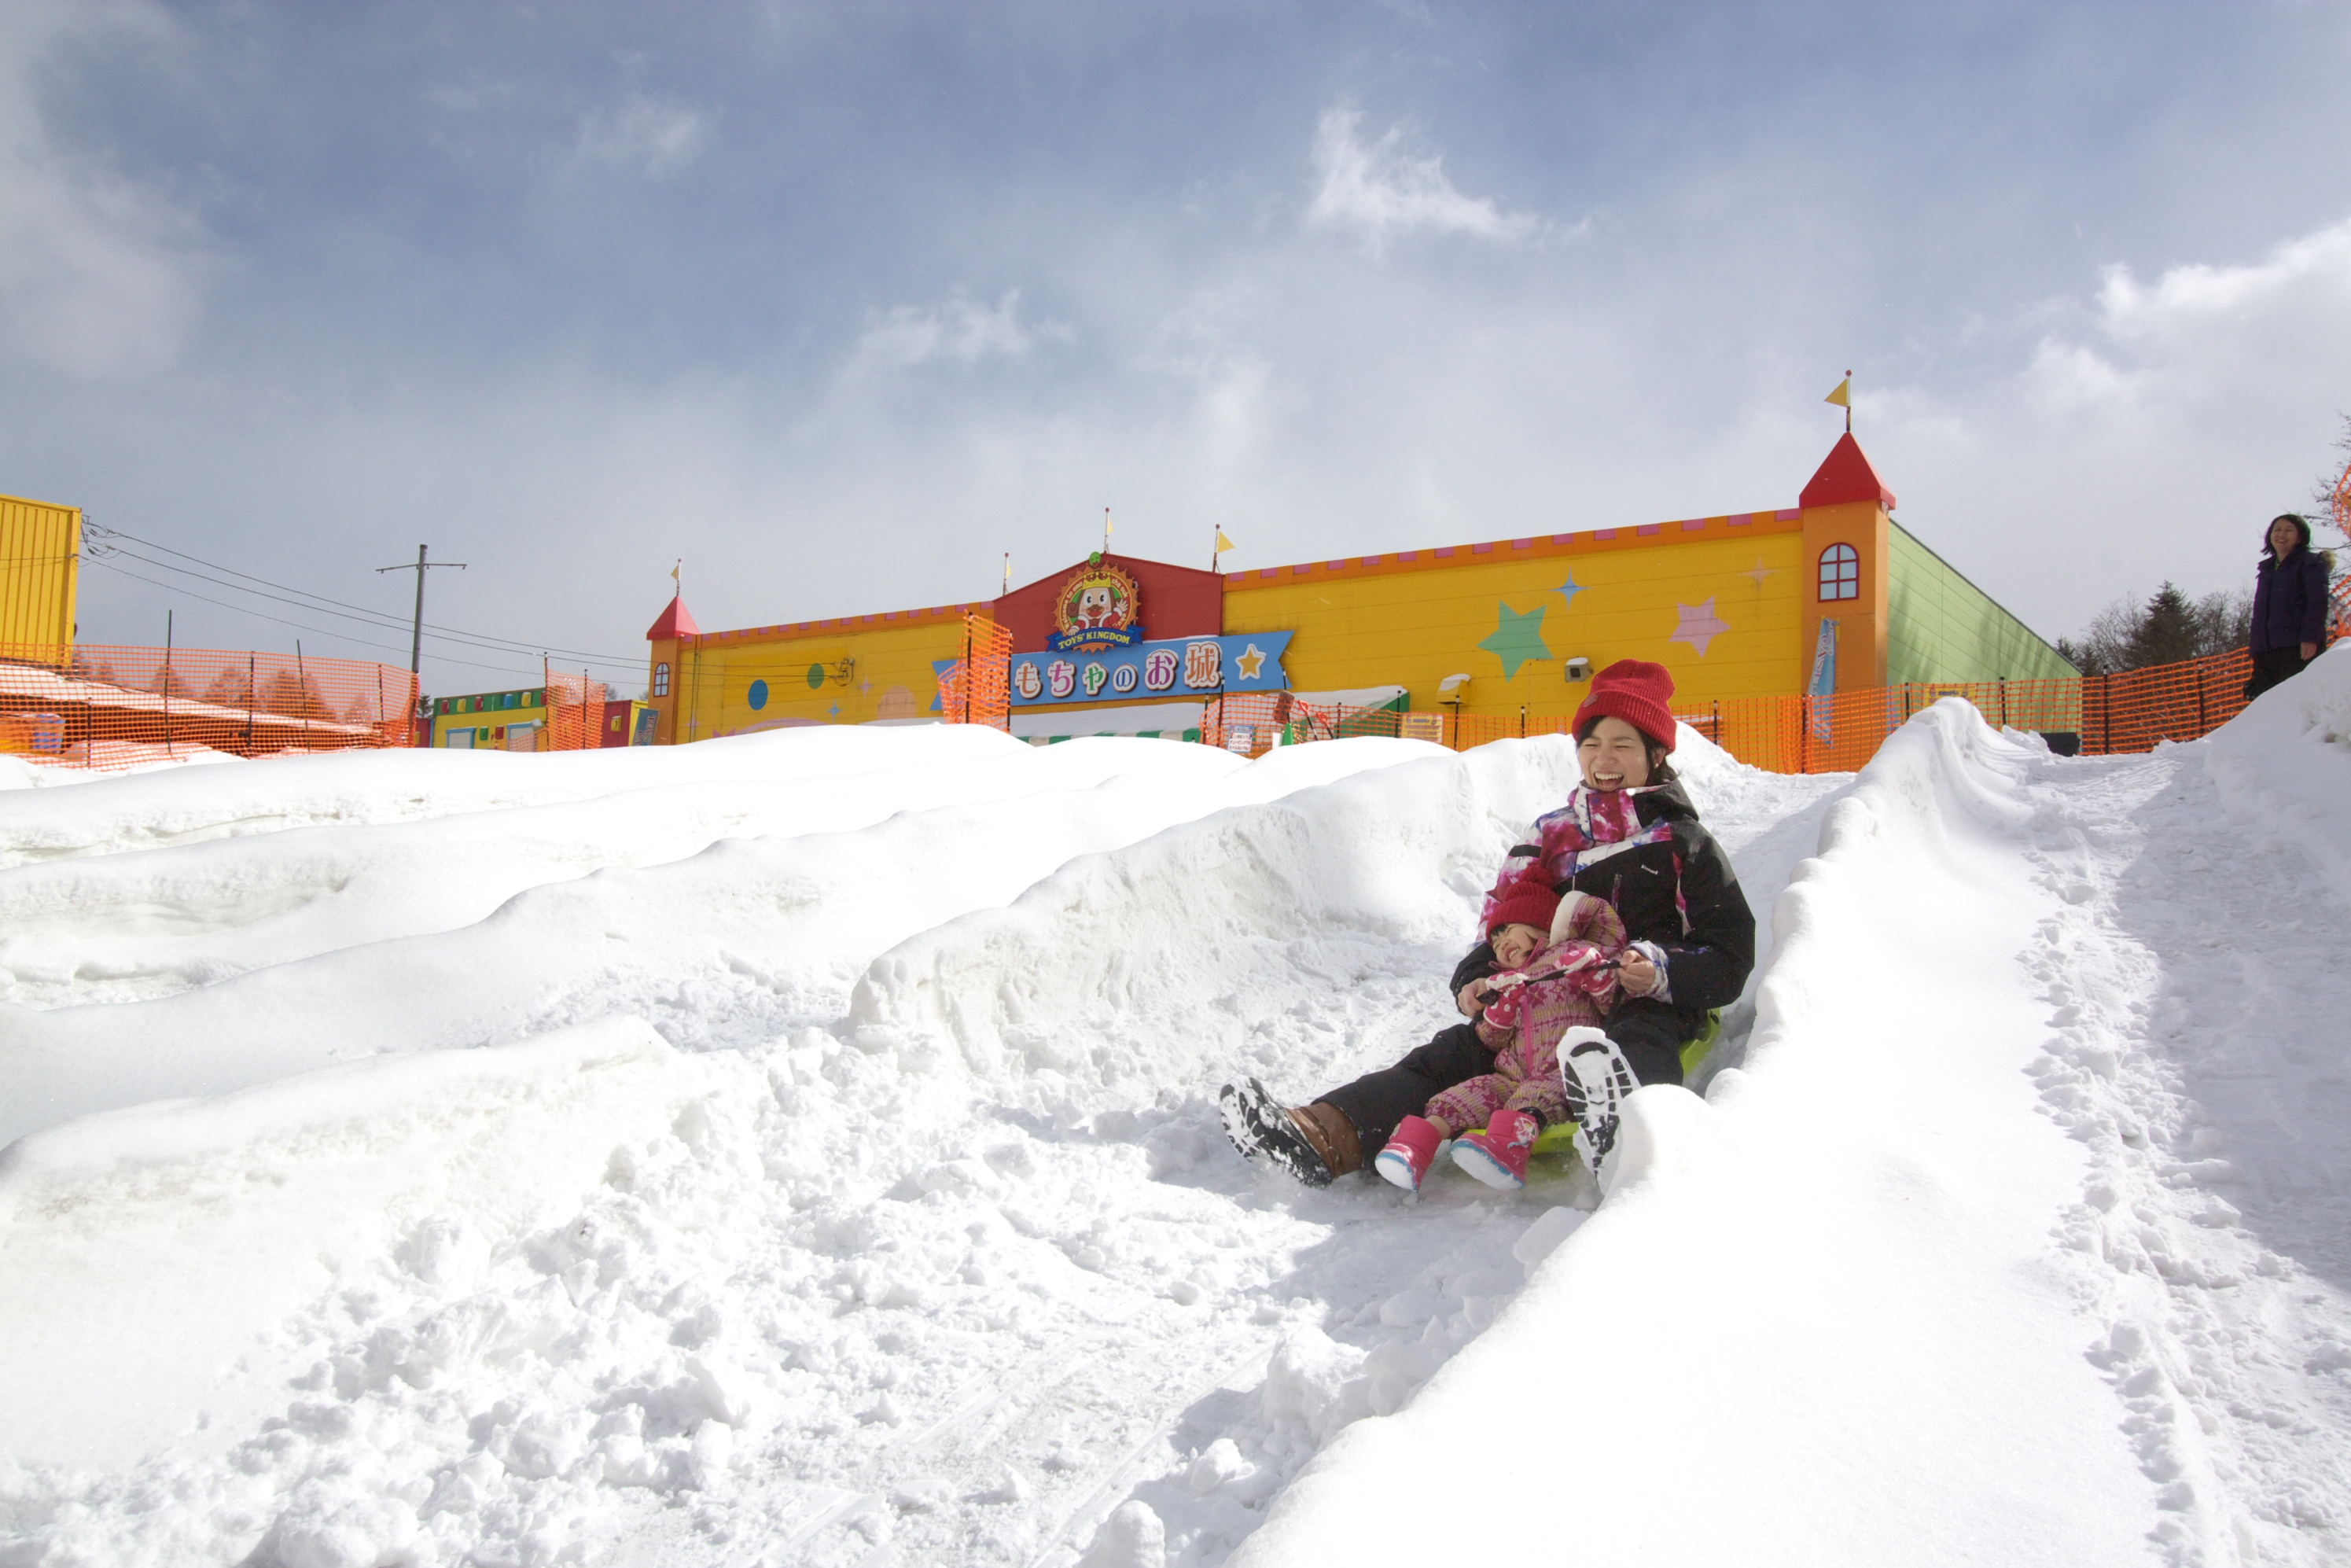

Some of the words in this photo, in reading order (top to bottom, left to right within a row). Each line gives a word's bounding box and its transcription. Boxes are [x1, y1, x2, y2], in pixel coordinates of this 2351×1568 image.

[1086, 631, 1130, 644] KINGDOM
[980, 642, 1222, 699] もちゃのお城
